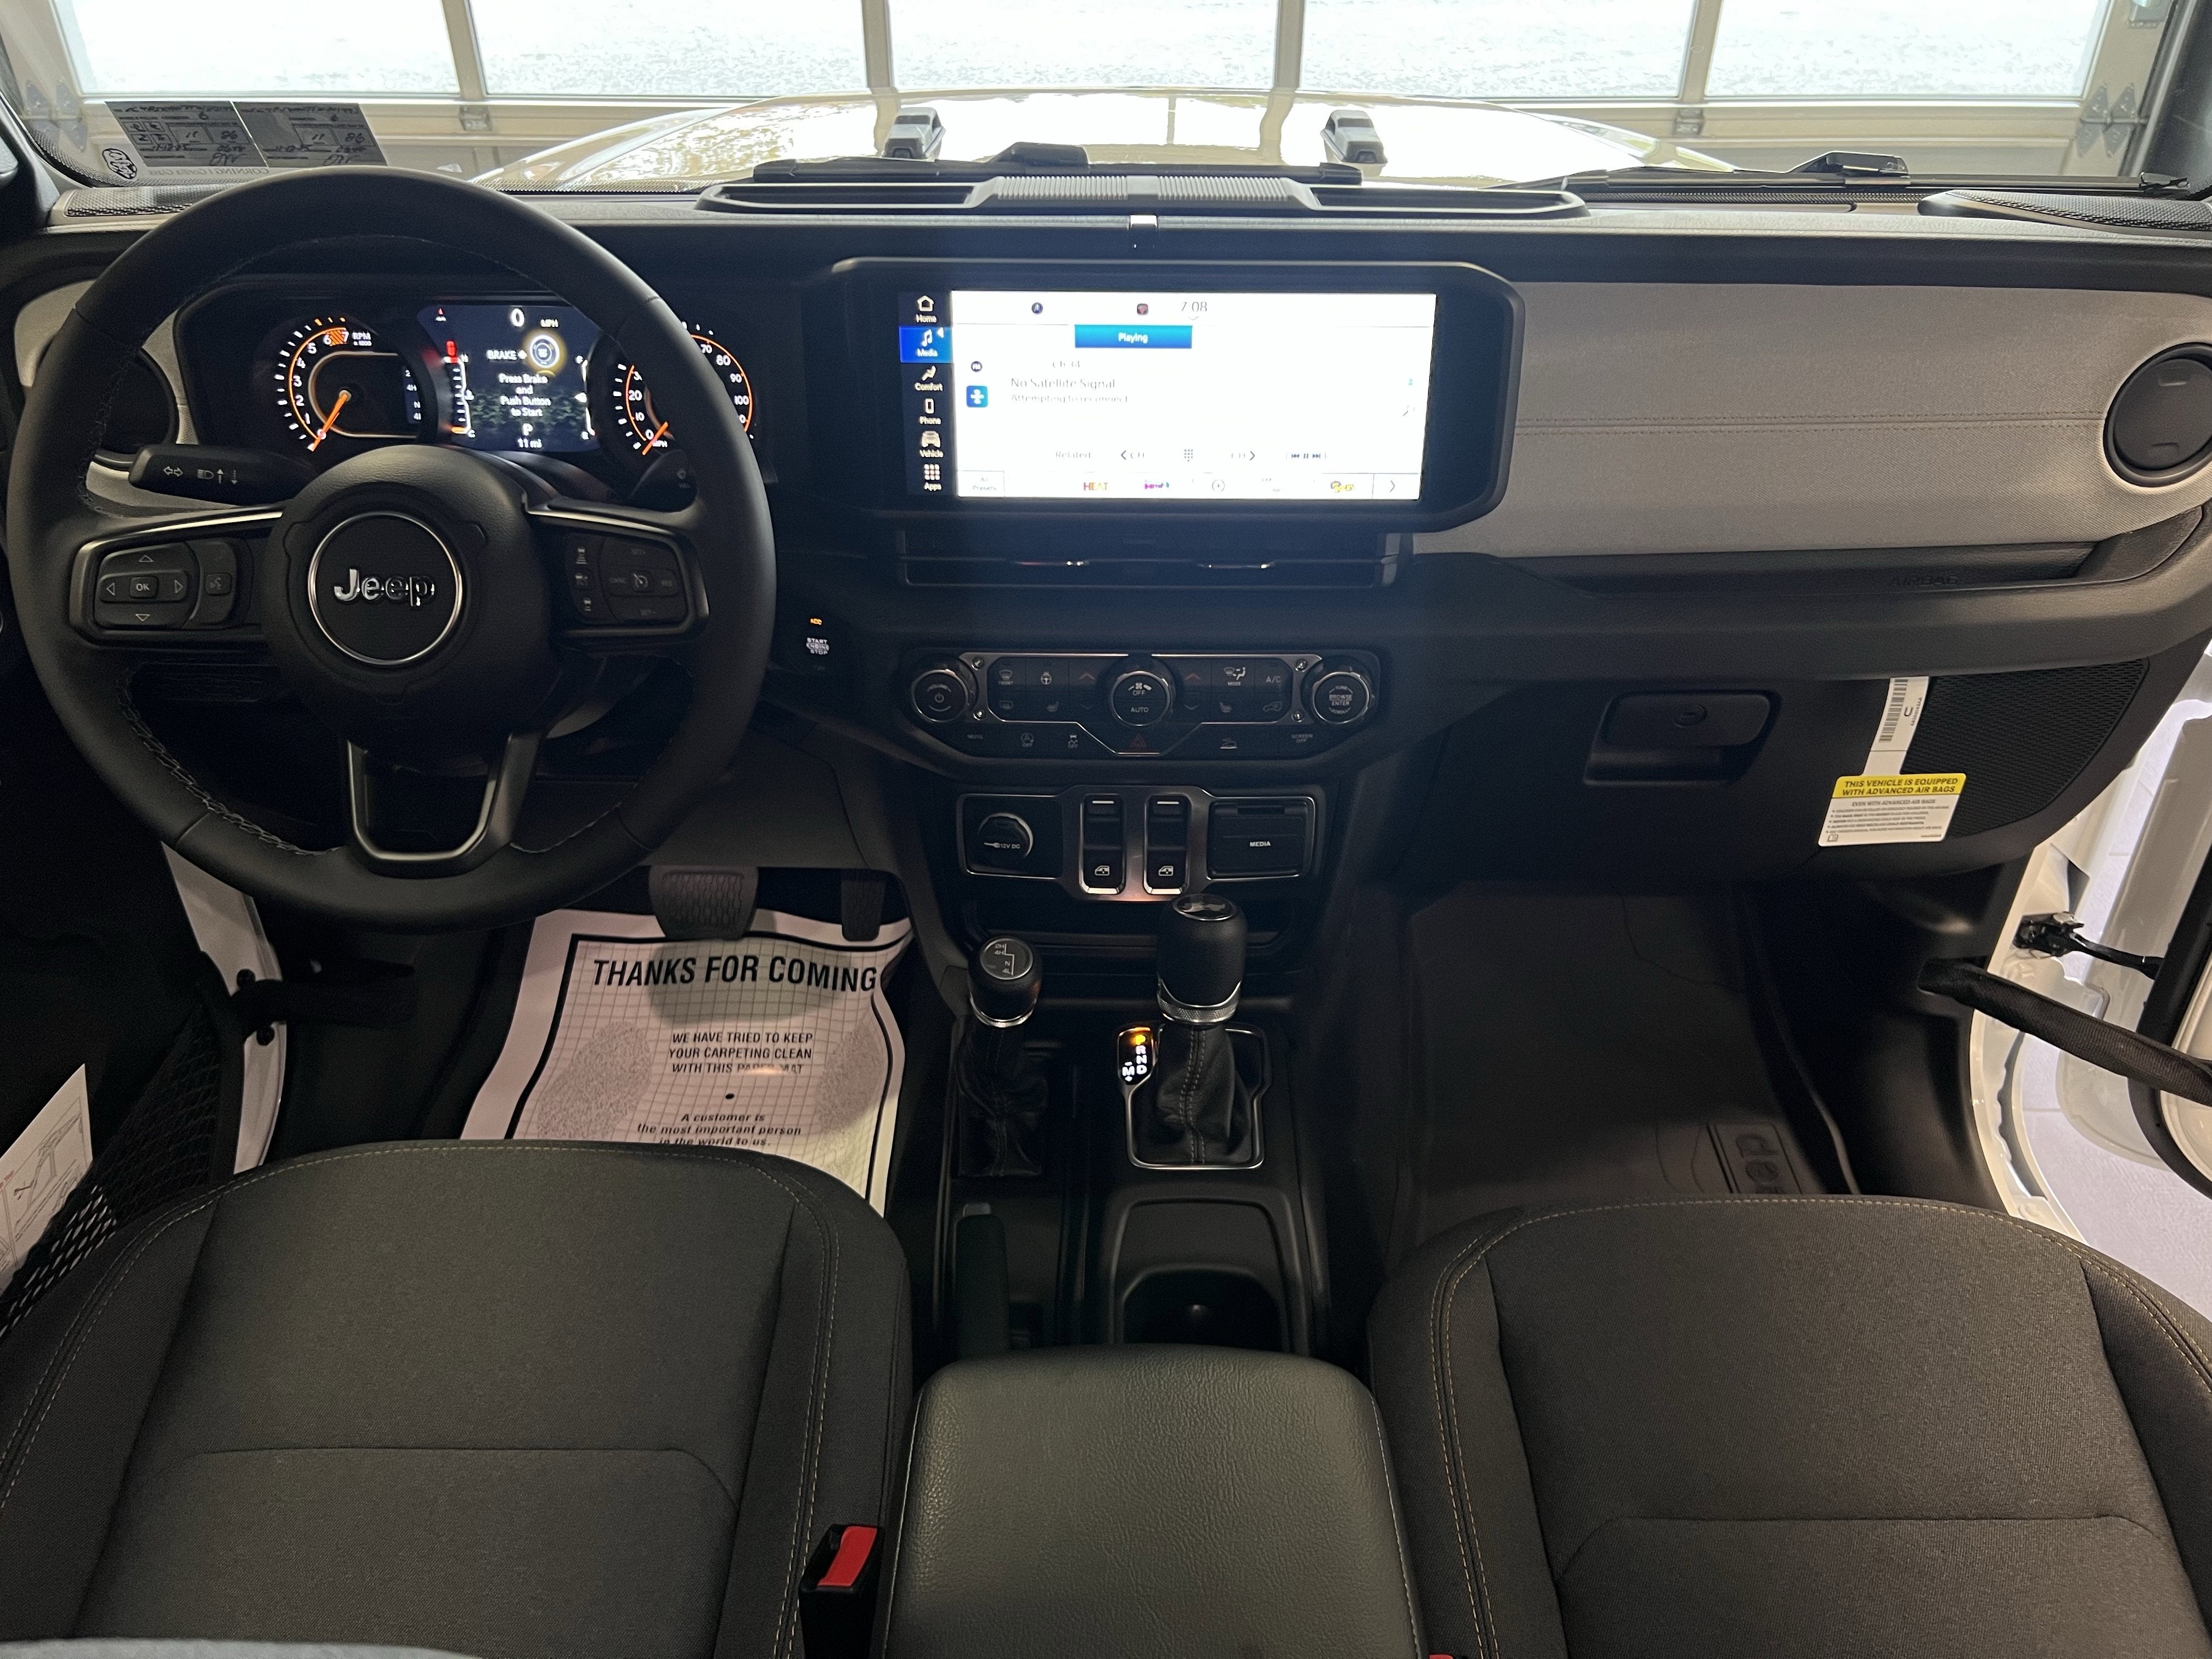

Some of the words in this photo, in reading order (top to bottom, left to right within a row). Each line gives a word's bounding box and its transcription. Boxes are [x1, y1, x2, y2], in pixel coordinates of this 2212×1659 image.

[1181, 301, 1207, 312] 708
[511, 308, 524, 327] 0
[916, 315, 937, 323] Home
[540, 319, 558, 328] MPH
[323, 334, 332, 345] 6
[343, 331, 349, 342] 7
[352, 331, 371, 340] RPM
[1118, 332, 1148, 343] Playing
[307, 342, 317, 354] 5
[701, 344, 712, 354] 70
[917, 348, 938, 357] Media
[487, 349, 517, 360] BRAKE
[716, 354, 731, 366] 80
[296, 357, 306, 368] 4
[293, 375, 302, 387] 3
[499, 373, 522, 383] Press
[523, 373, 548, 384] Brake
[730, 373, 742, 383] 90
[516, 385, 533, 394] and
[915, 382, 943, 392] Comfort
[1011, 378, 1027, 387] No
[1030, 378, 1076, 388] Satellite
[1080, 379, 1115, 390] Signal
[294, 394, 304, 407] 2
[628, 390, 642, 401] 20
[734, 395, 749, 405] 100
[500, 396, 522, 406] Push
[523, 396, 551, 407] Button
[511, 408, 521, 417] to
[521, 408, 543, 417] Start
[635, 412, 645, 421] 10
[305, 413, 311, 424] 1
[919, 416, 941, 426] Phone
[523, 424, 533, 436] P
[645, 429, 654, 440] 0
[518, 438, 529, 448] 11
[919, 449, 944, 459] Vehicle
[924, 482, 942, 492] Apps
[1083, 482, 1108, 491] HEAT
[136, 583, 150, 592] OK
[334, 568, 435, 607] Jeep
[1865, 787, 1914, 795] ADVANCED
[593, 957, 697, 986] THANKS
[704, 955, 760, 983] FOR
[769, 956, 878, 991] COMING
[673, 1033, 690, 1043] WE
[693, 1032, 723, 1043] HAVE
[727, 1032, 760, 1043] TRIED
[766, 1032, 779, 1043] TO
[783, 1032, 813, 1043] KEEP
[1136, 1034, 1146, 1045] P
[669, 1047, 700, 1058] YOUR
[704, 1047, 770, 1059] CARPETING
[774, 1048, 812, 1059] CLEAN
[1136, 1045, 1146, 1054] R
[1136, 1054, 1147, 1064] N
[672, 1063, 702, 1073] WITH
[707, 1063, 733, 1073] THIS
[1122, 1066, 1135, 1076] M
[1137, 1064, 1148, 1075] D
[681, 1114, 690, 1122] A
[693, 1114, 751, 1122] customer
[755, 1114, 765, 1122] is
[637, 1124, 657, 1134] the
[661, 1125, 691, 1134] most
[695, 1125, 755, 1135] important
[759, 1126, 801, 1136] person
[674, 1137, 693, 1145] the
[698, 1136, 732, 1146] world
